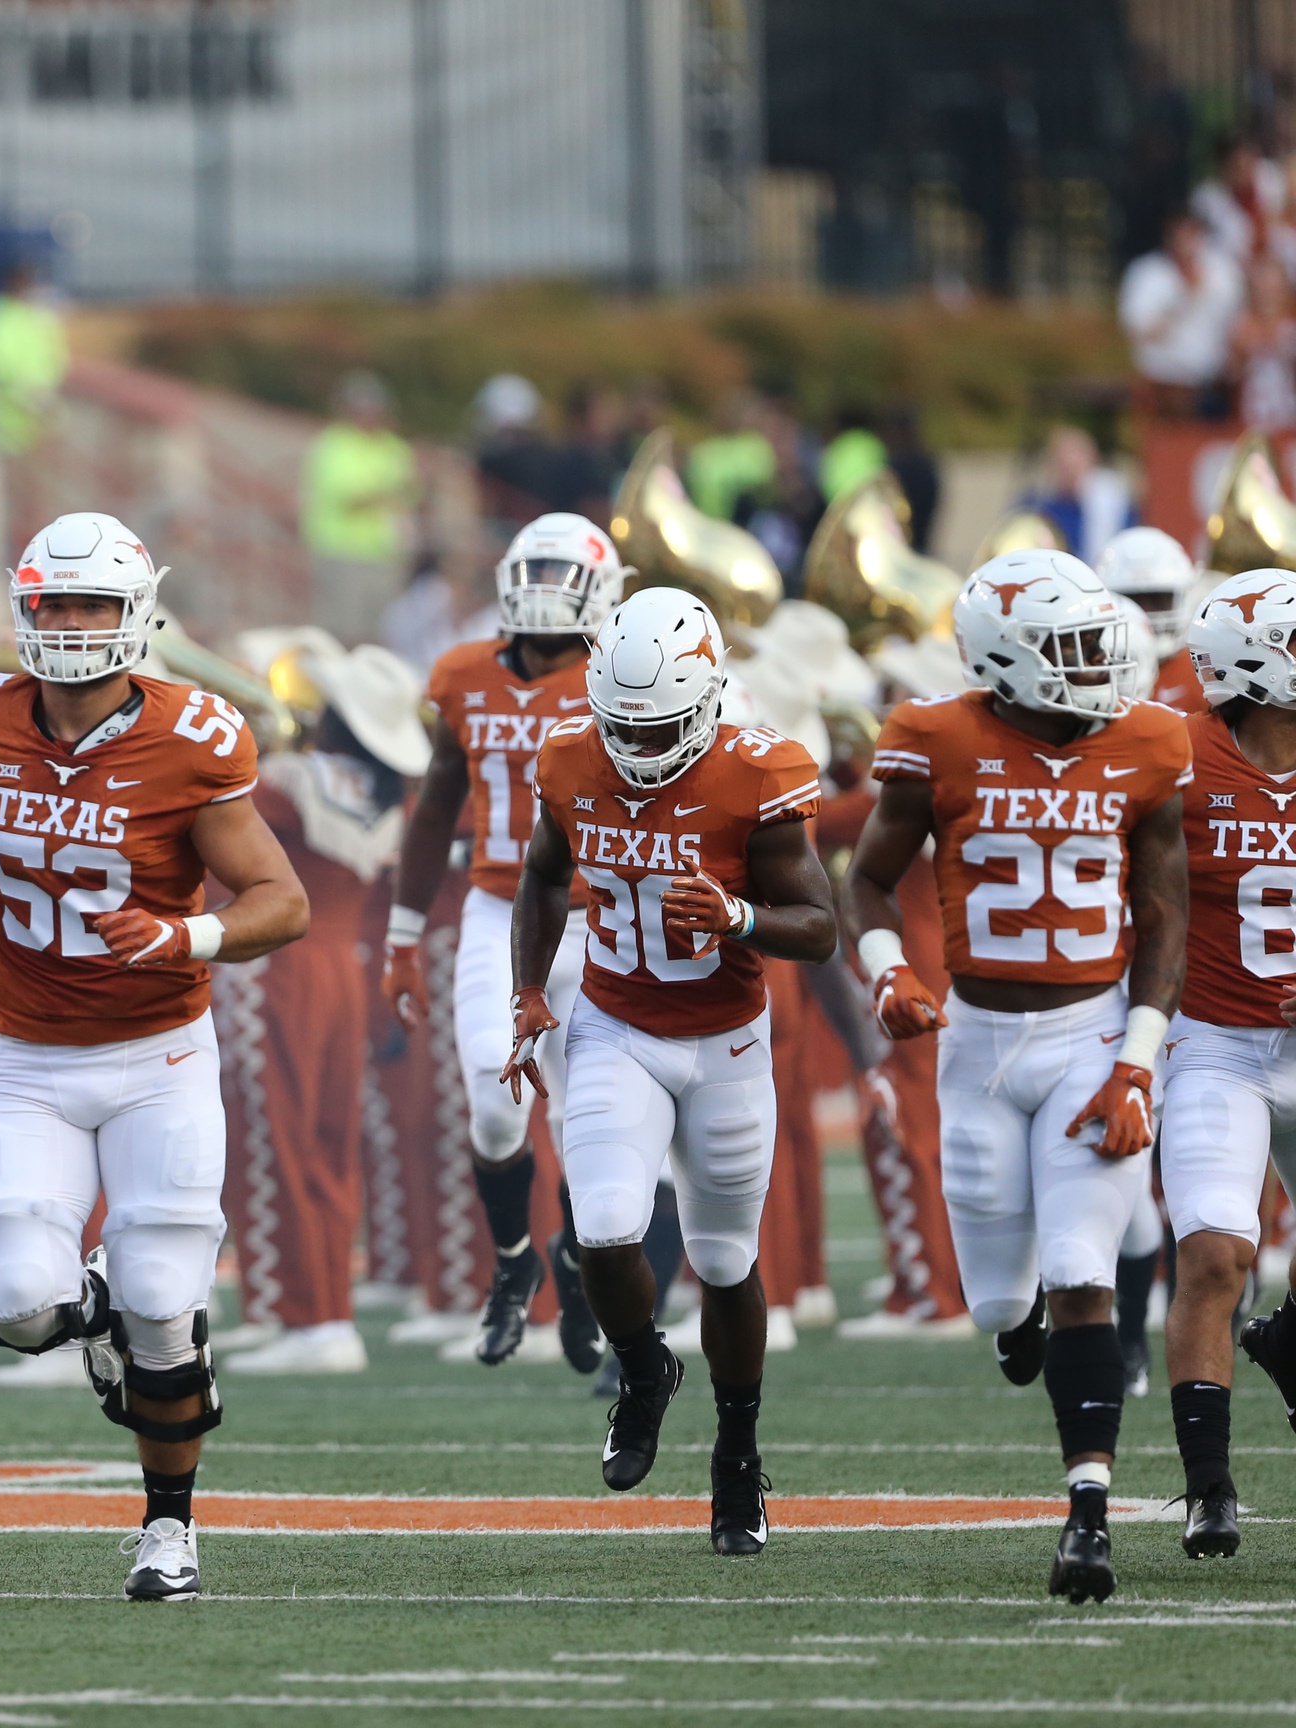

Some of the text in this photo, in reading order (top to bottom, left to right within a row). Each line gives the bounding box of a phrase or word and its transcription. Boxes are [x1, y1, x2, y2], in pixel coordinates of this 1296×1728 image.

[53, 571, 80, 580] HORNS
[173, 690, 245, 757] 52
[619, 701, 645, 711] HORNS
[465, 713, 560, 751] TEX
[976, 786, 1128, 831] TEXAS
[576, 820, 701, 871] TEXAS
[1208, 819, 1296, 861] TEX
[961, 832, 1125, 963] 29
[577, 863, 722, 983] 30
